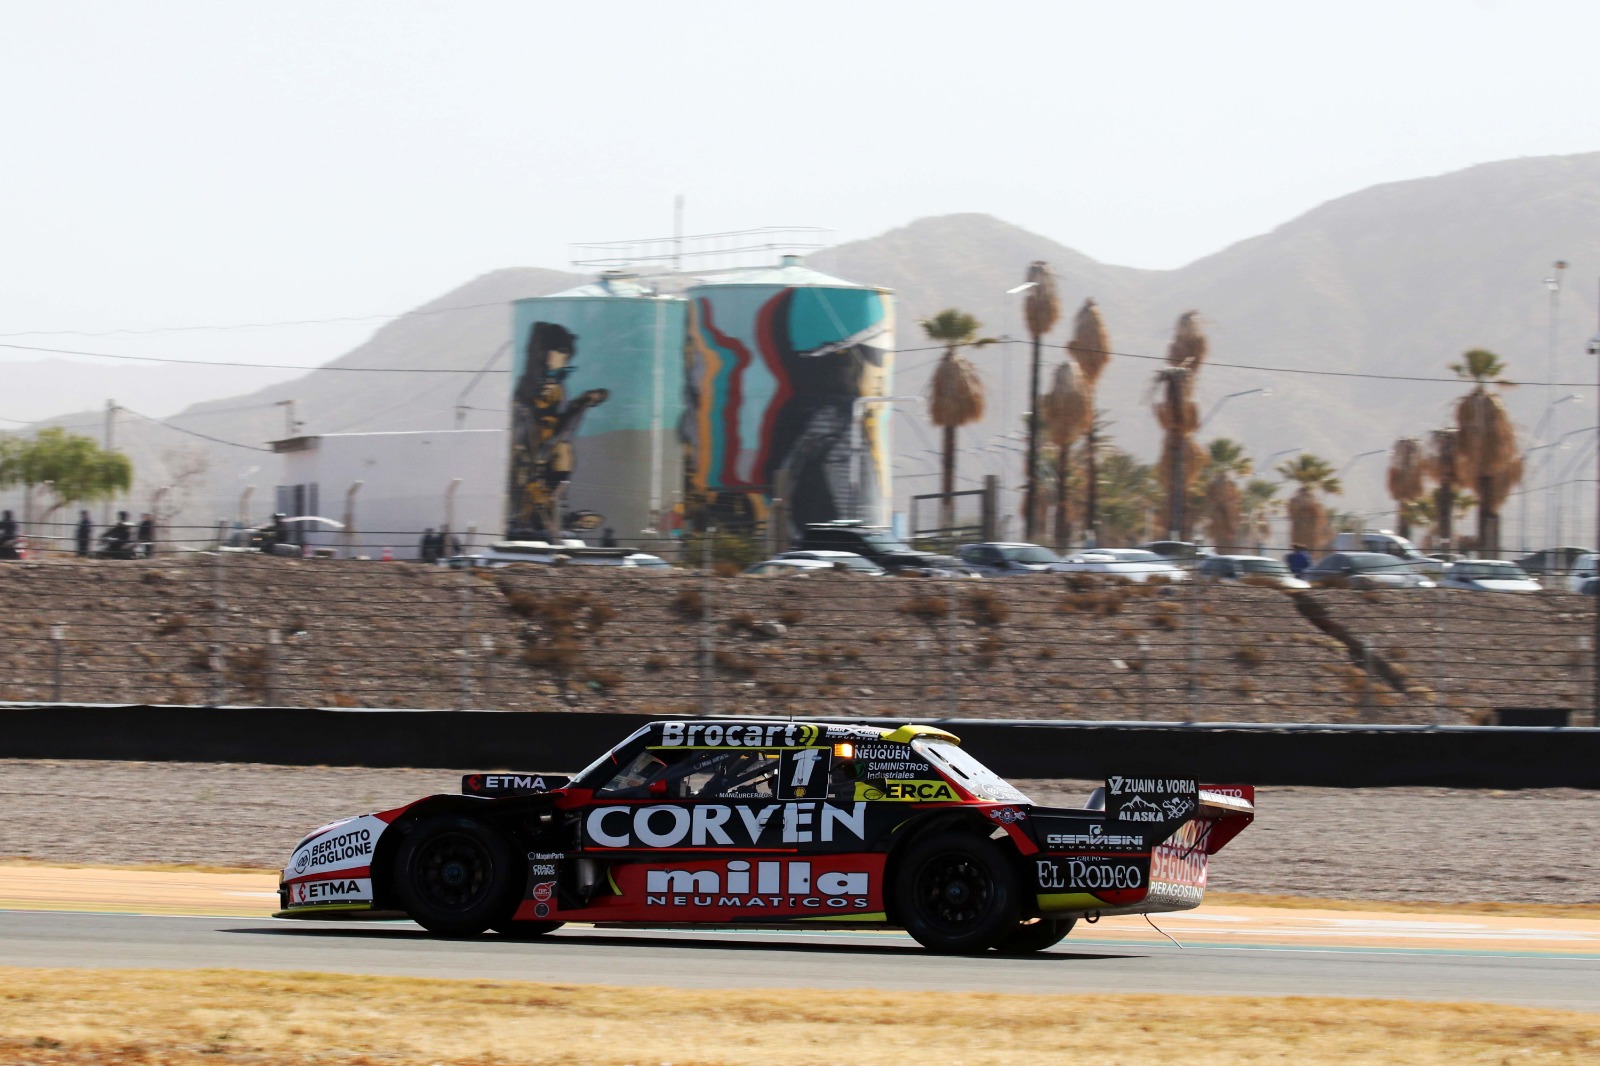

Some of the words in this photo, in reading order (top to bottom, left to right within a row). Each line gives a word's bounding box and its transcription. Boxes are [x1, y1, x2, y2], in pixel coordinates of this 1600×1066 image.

[662, 722, 797, 746] Brocart
[854, 749, 911, 760] NEUQUEN
[791, 749, 818, 786] 1
[868, 762, 929, 771] SUMINISTROS
[485, 776, 547, 789] ETMA
[867, 771, 915, 780] Industriales
[885, 783, 953, 799] ERCA
[1125, 779, 1155, 793] ZUAIN
[1156, 779, 1165, 793] &
[1166, 779, 1196, 794] VORIA
[586, 801, 867, 848] CORVEN
[1119, 811, 1164, 822] ALASKA
[312, 829, 370, 856] BERTOTTO
[1047, 834, 1143, 845] GERVASINI
[310, 842, 372, 867] ROGLIONE
[1153, 846, 1206, 884] SEGUROS
[646, 860, 869, 895] milla
[309, 880, 361, 898] ETMA
[1150, 881, 1204, 900] PIERAGOSTINI
[646, 896, 869, 907] NEUMATICOS
